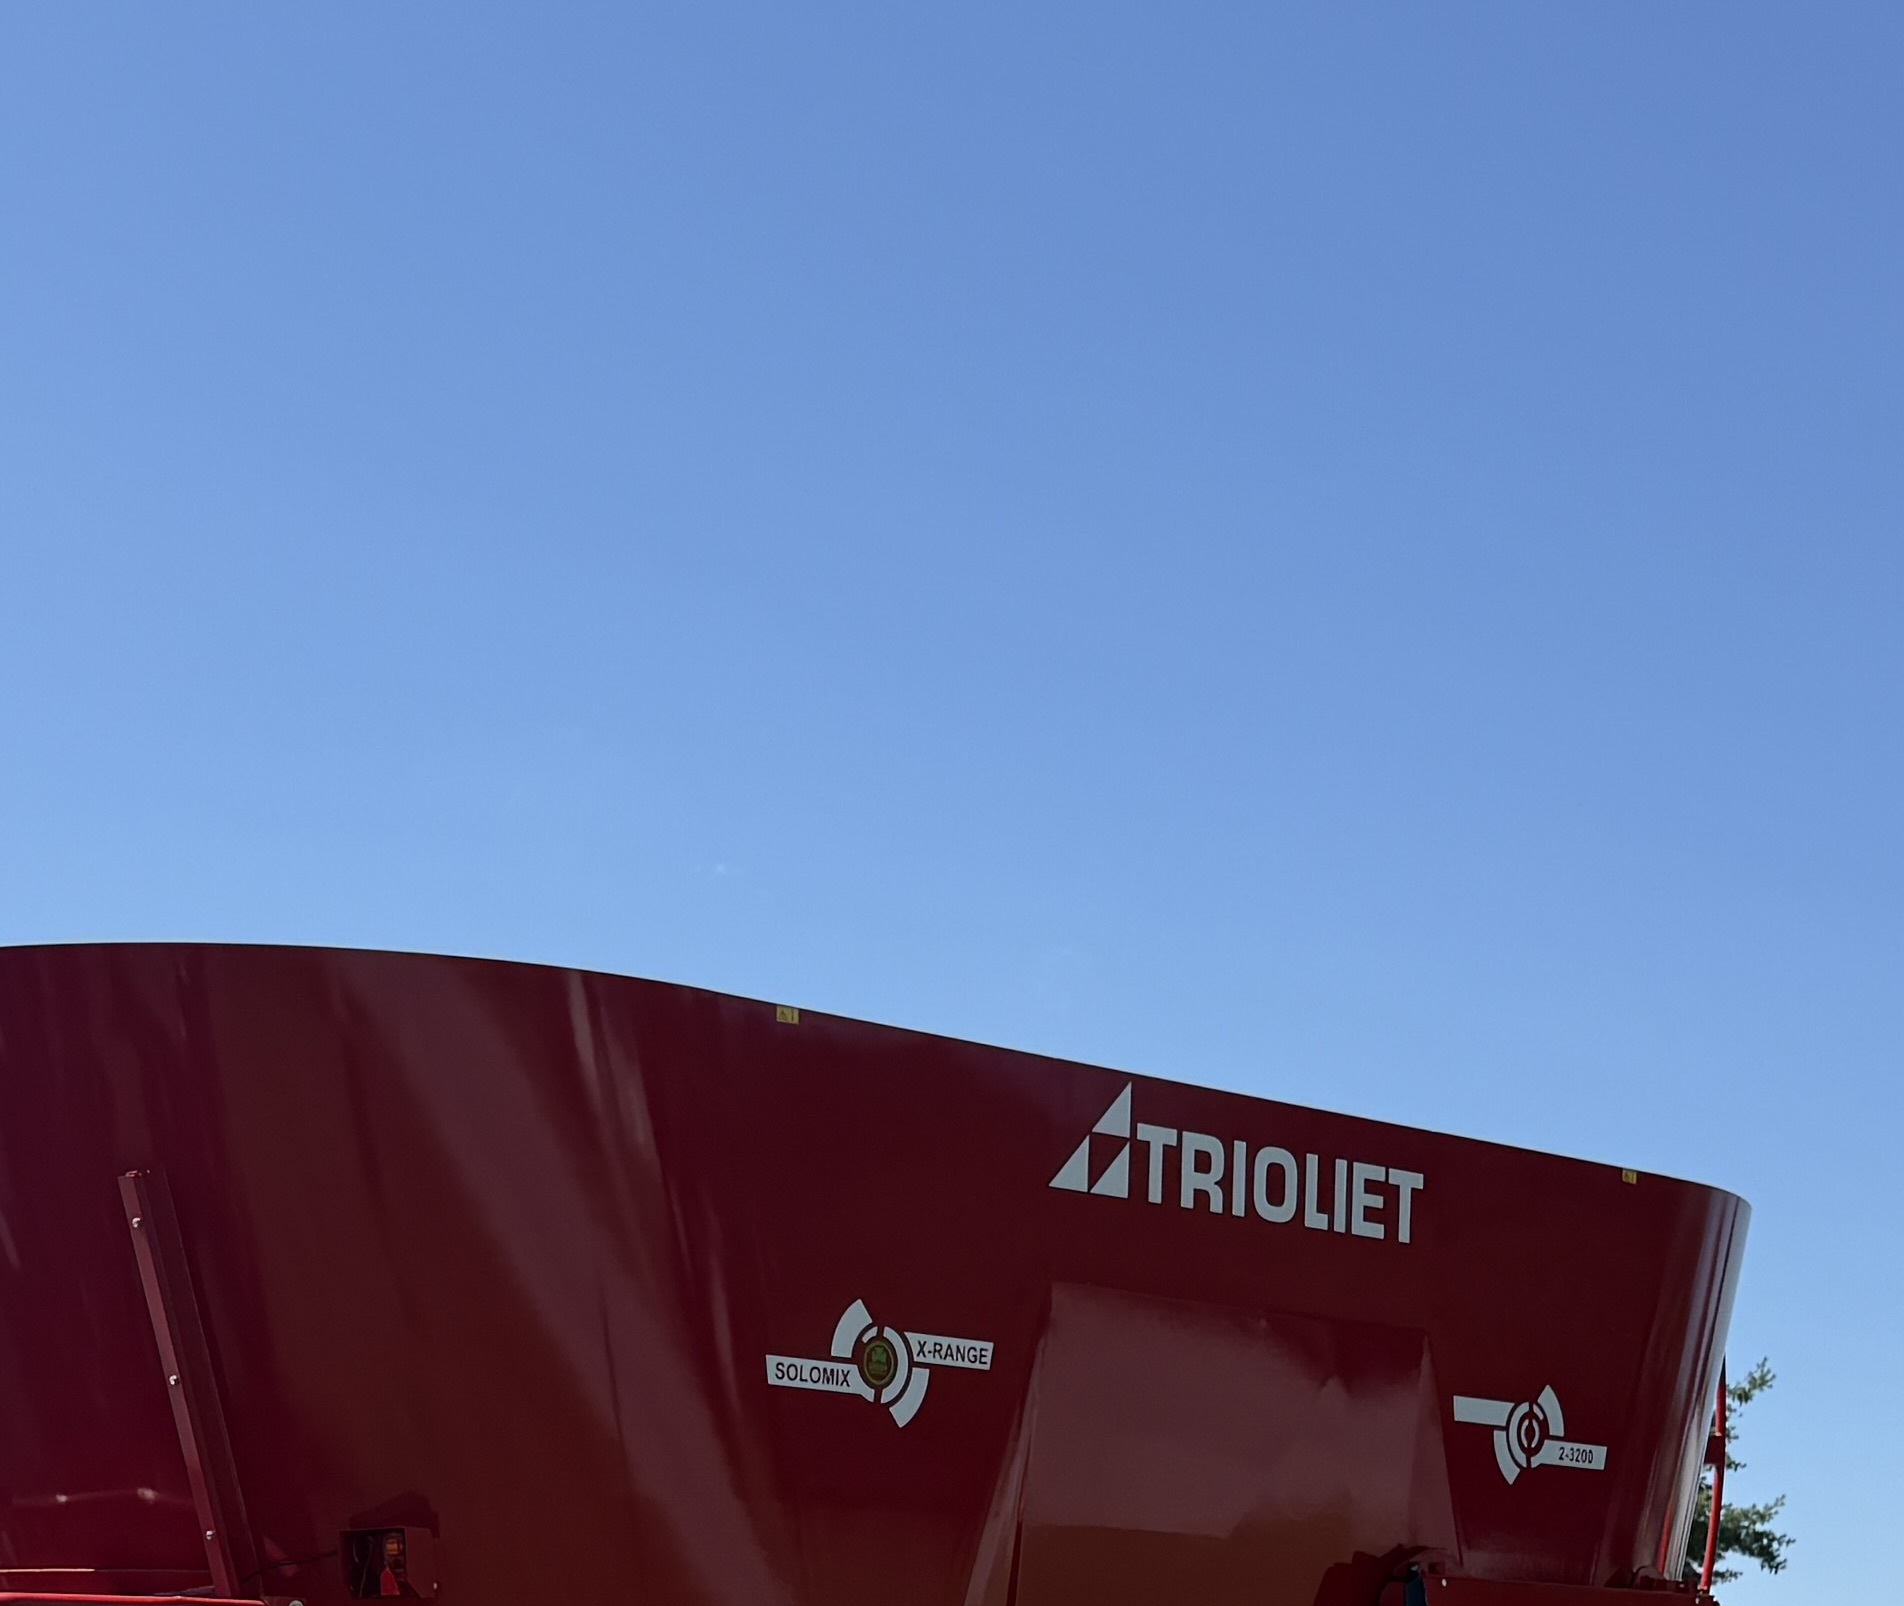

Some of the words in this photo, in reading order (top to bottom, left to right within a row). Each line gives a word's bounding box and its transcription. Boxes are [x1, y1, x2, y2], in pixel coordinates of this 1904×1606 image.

[1136, 1122, 1424, 1244] TRIOLIET
[916, 1340, 989, 1366] X-RANGE
[775, 1361, 851, 1388] SOLOMIX
